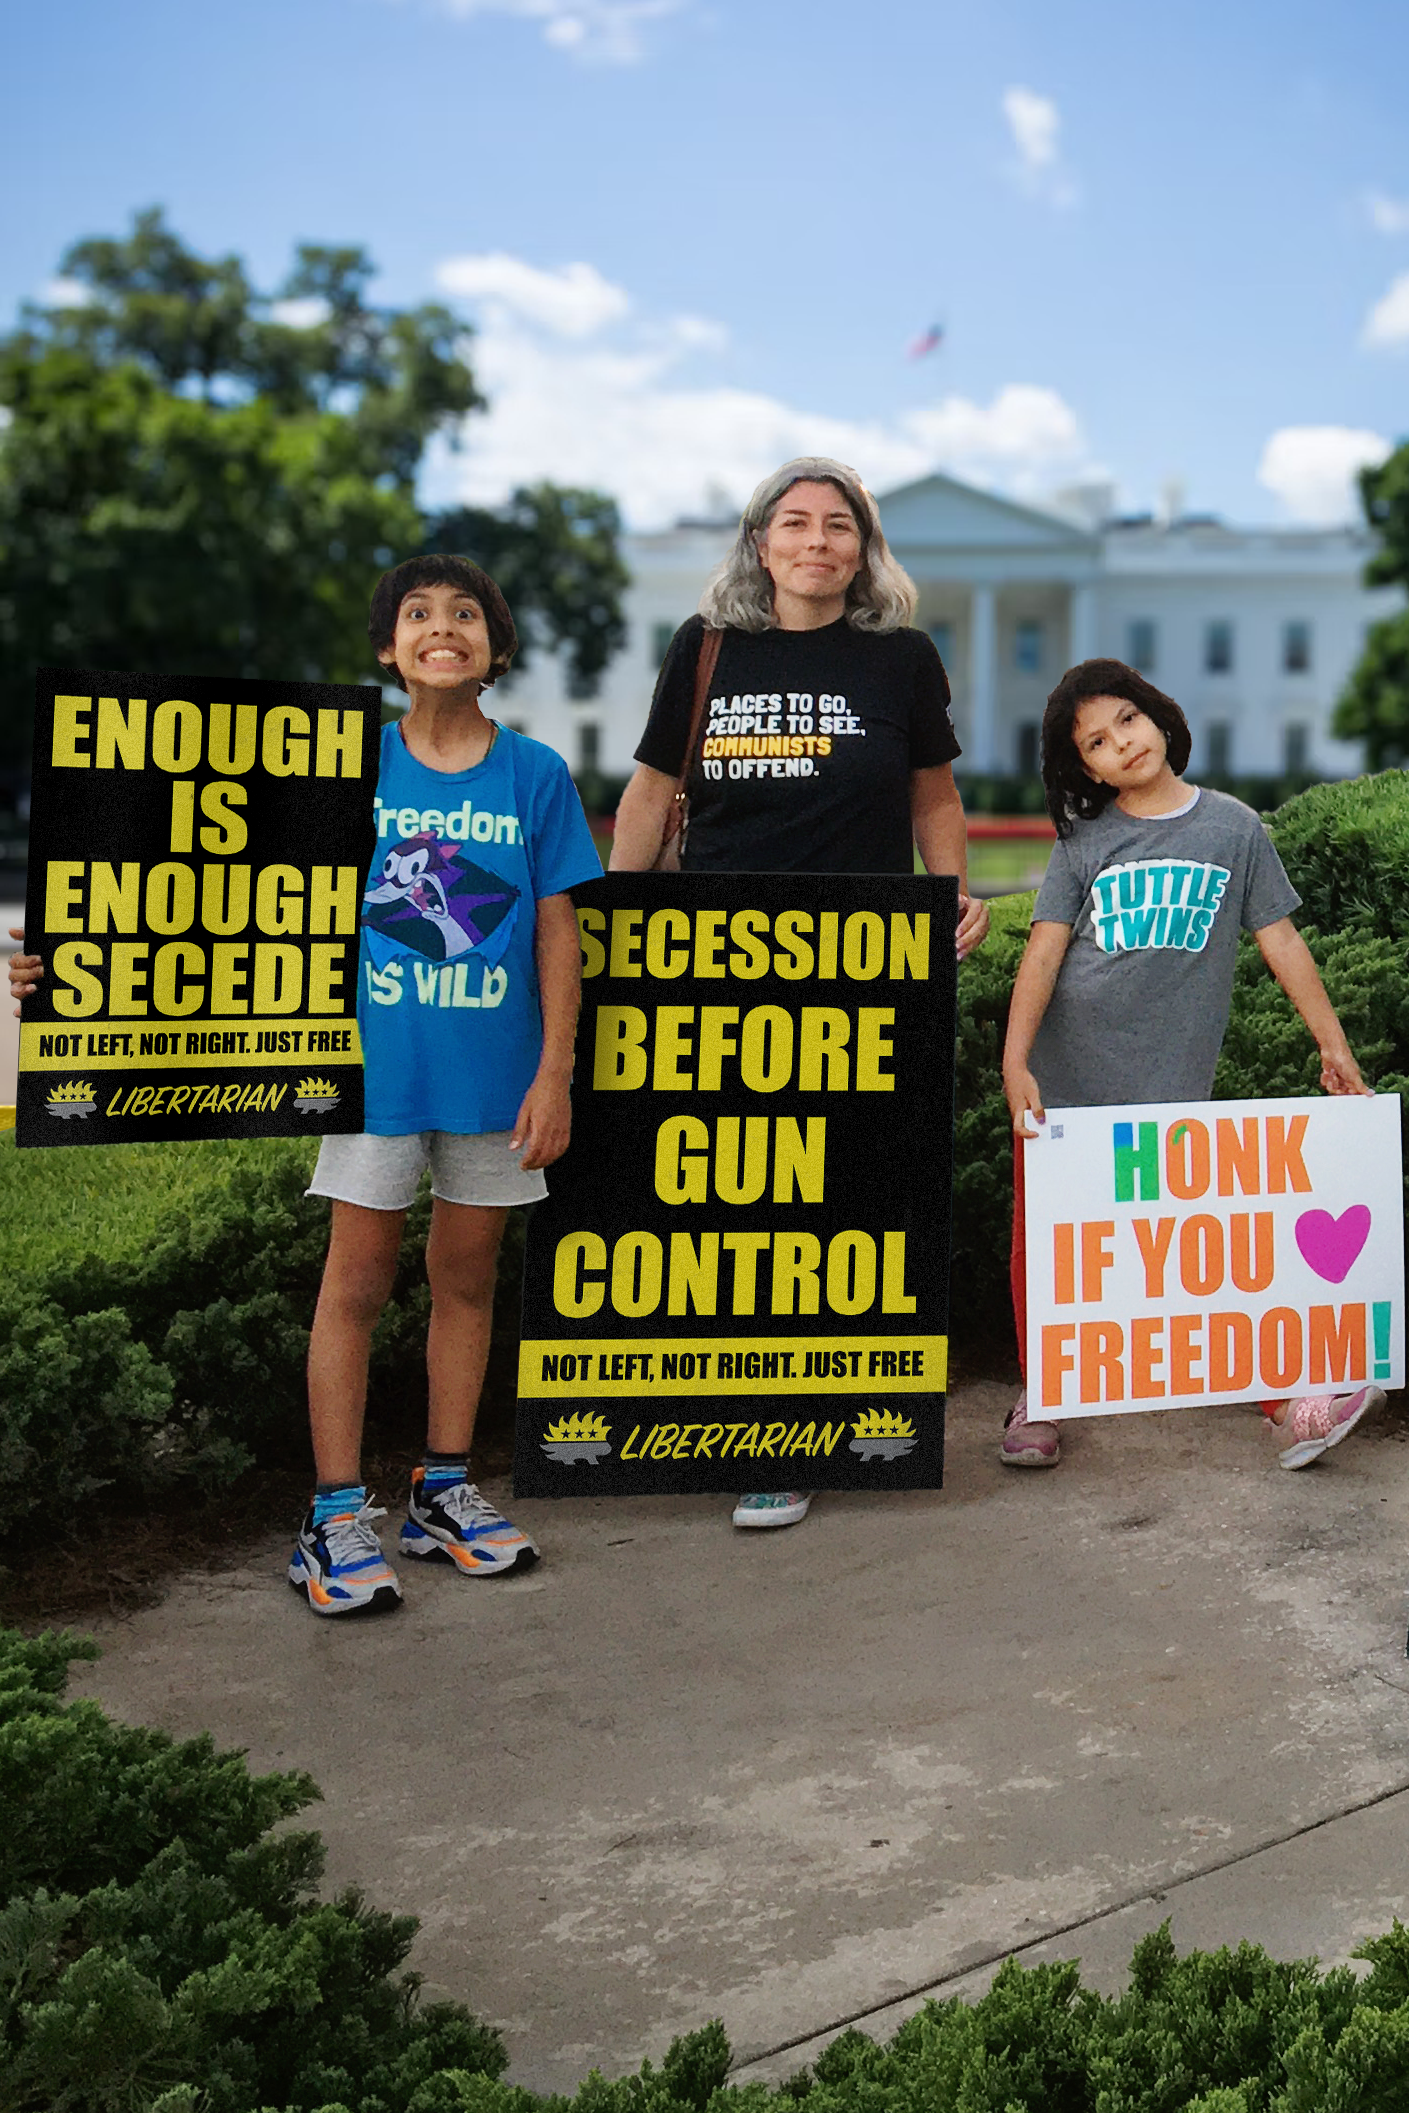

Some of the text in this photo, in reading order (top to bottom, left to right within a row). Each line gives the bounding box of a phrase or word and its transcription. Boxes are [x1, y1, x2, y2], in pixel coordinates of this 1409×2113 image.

[51, 694, 364, 779] ENOUGH
[705, 714, 867, 737] PEOPLE TO SEE,
[708, 692, 852, 718] PLACES TO GO,
[701, 757, 820, 780] TO OFFEND.
[702, 735, 832, 758] COMMUNISTS
[170, 780, 248, 855] IS
[44, 860, 358, 936] ENOUGH
[1093, 864, 1230, 916] TUTTLE
[576, 907, 931, 981] SECESSION
[1097, 905, 1213, 953] TWINS
[52, 940, 346, 1018] SECEDE
[413, 961, 508, 1009] WILD
[39, 1030, 352, 1059] NOT LEFT, NOT RIGHT. JUST FREE
[592, 1004, 896, 1093] BEFORE
[105, 1082, 289, 1118] LIBERTARIAN
[654, 1114, 827, 1206] GUN
[1113, 1114, 1313, 1203] HONK
[552, 1229, 917, 1318] CONTROL
[1053, 1211, 1275, 1305] IF YOU
[541, 1350, 925, 1384] NOT LEFT, NOT RIGHT. JUST FREE
[1041, 1301, 1392, 1407] FREEDOM!
[619, 1420, 846, 1461] LIBERTARIAN
